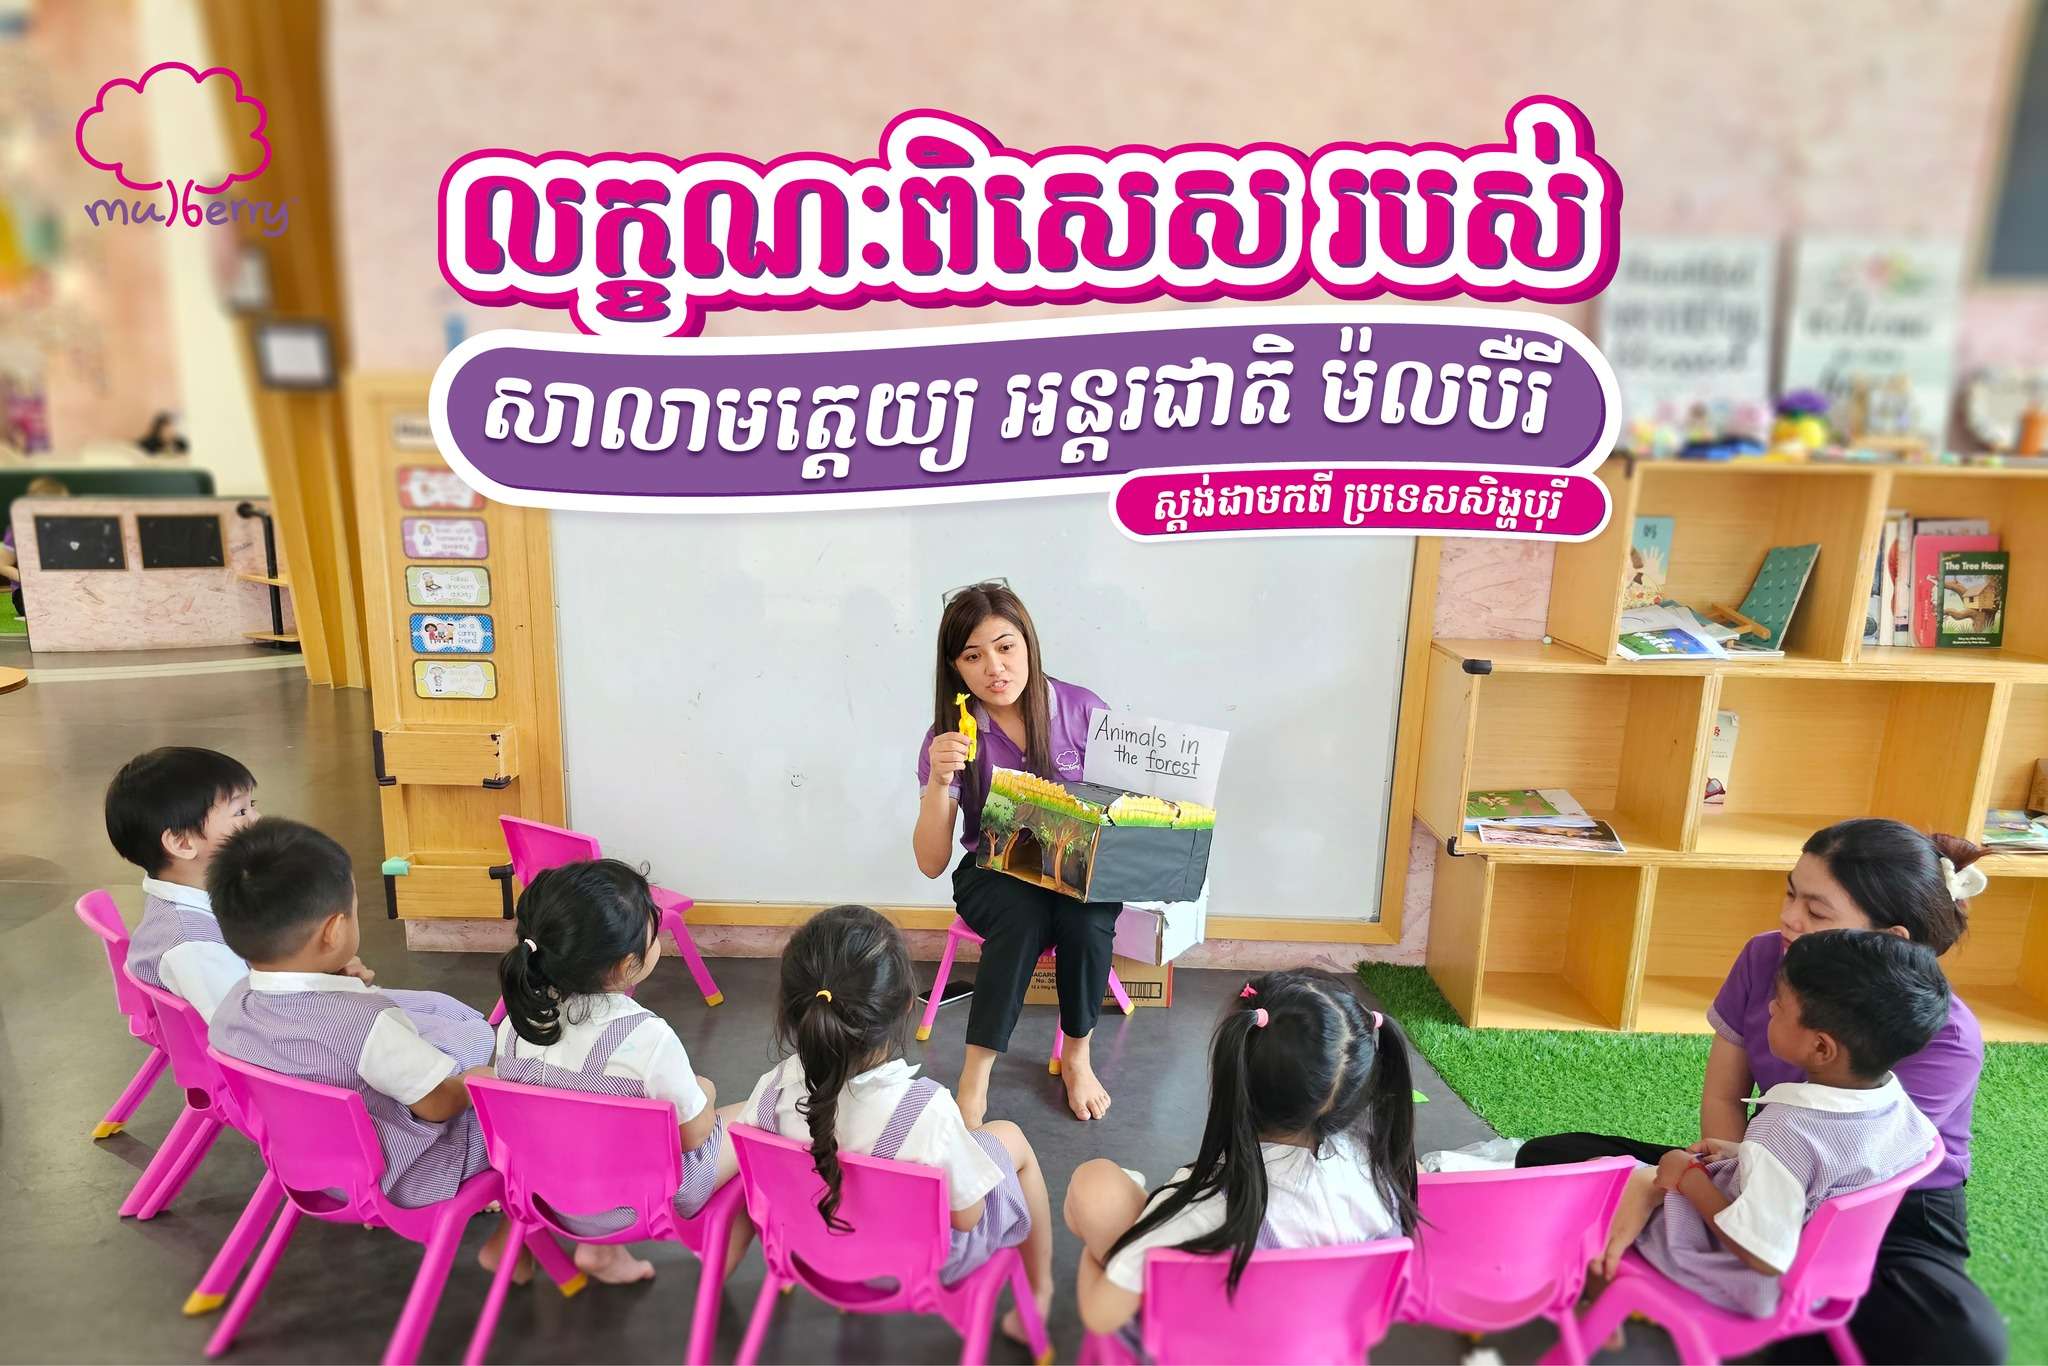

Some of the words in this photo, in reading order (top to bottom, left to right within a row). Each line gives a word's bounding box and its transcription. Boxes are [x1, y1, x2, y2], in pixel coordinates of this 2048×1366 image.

[1945, 561, 1960, 571] The
[1961, 561, 1980, 571] Tree
[1981, 561, 2005, 571] House
[1094, 714, 1167, 749] Animals
[1180, 734, 1200, 755] in
[1114, 744, 1138, 765] the
[1145, 749, 1201, 776] forest
